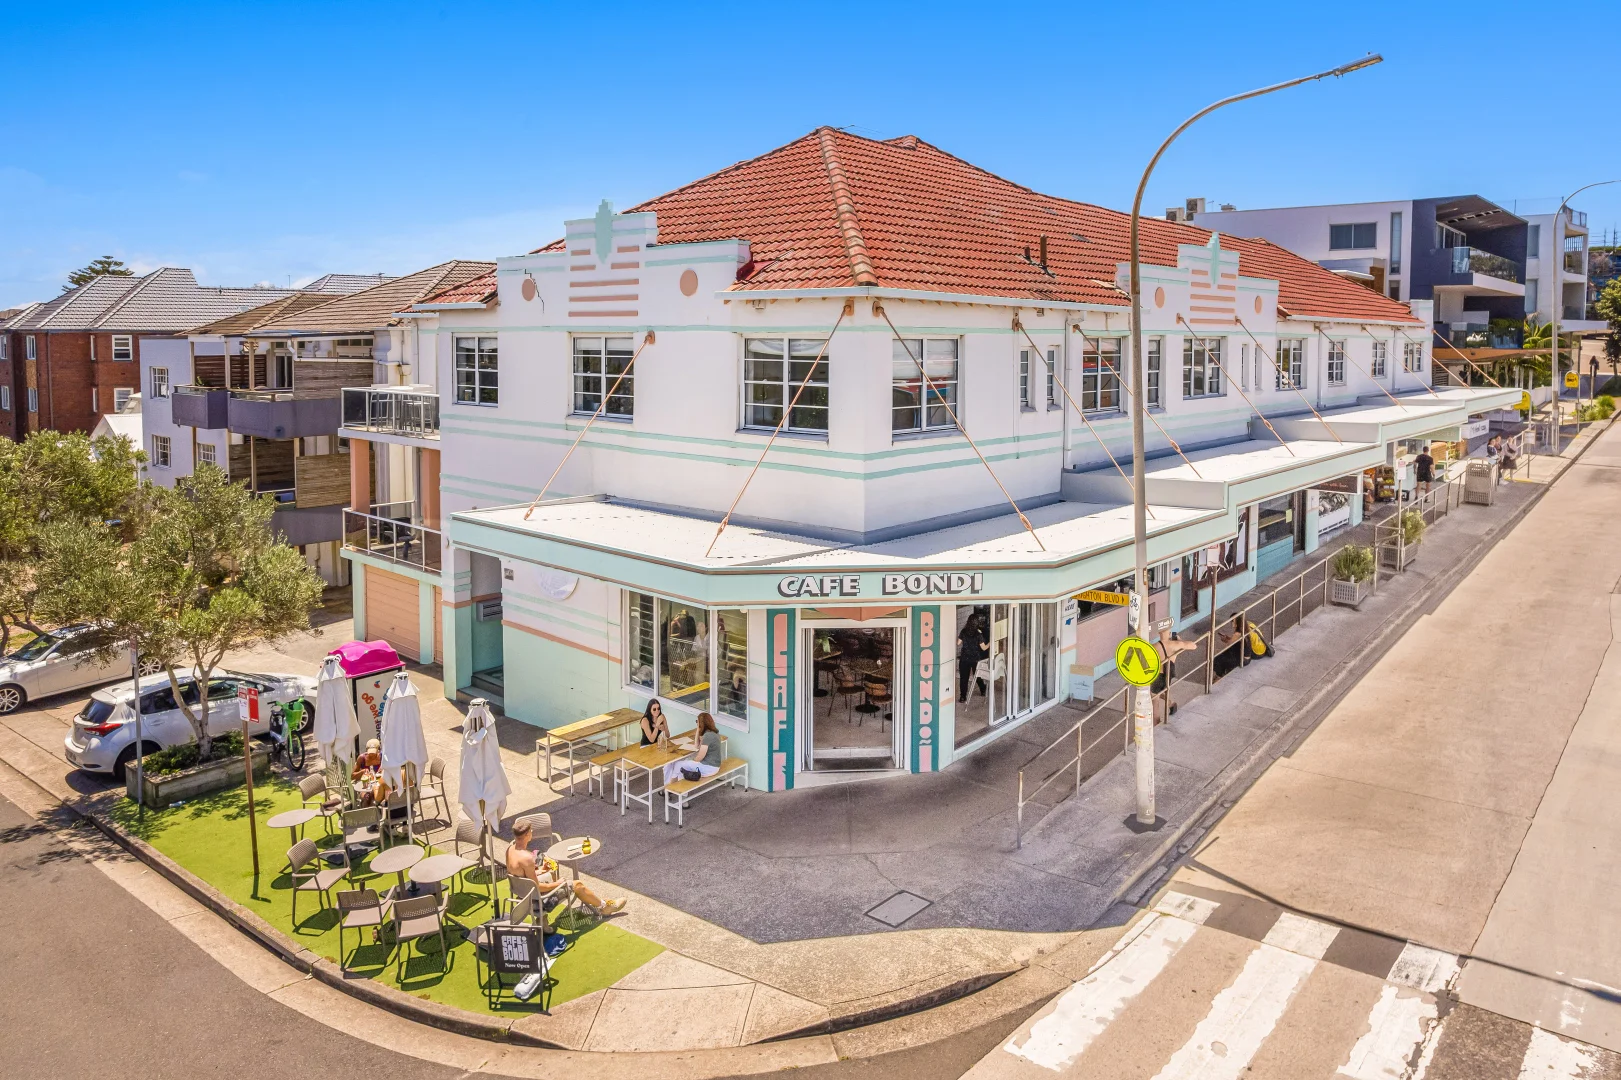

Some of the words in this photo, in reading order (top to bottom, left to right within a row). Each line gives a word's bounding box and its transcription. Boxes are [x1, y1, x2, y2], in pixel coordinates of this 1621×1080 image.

[777, 575, 860, 597] CAFE
[882, 572, 984, 597] BONDI
[1105, 593, 1120, 604] BLVD
[361, 693, 374, 704] go
[919, 612, 934, 772] BONDI
[370, 704, 379, 719] we
